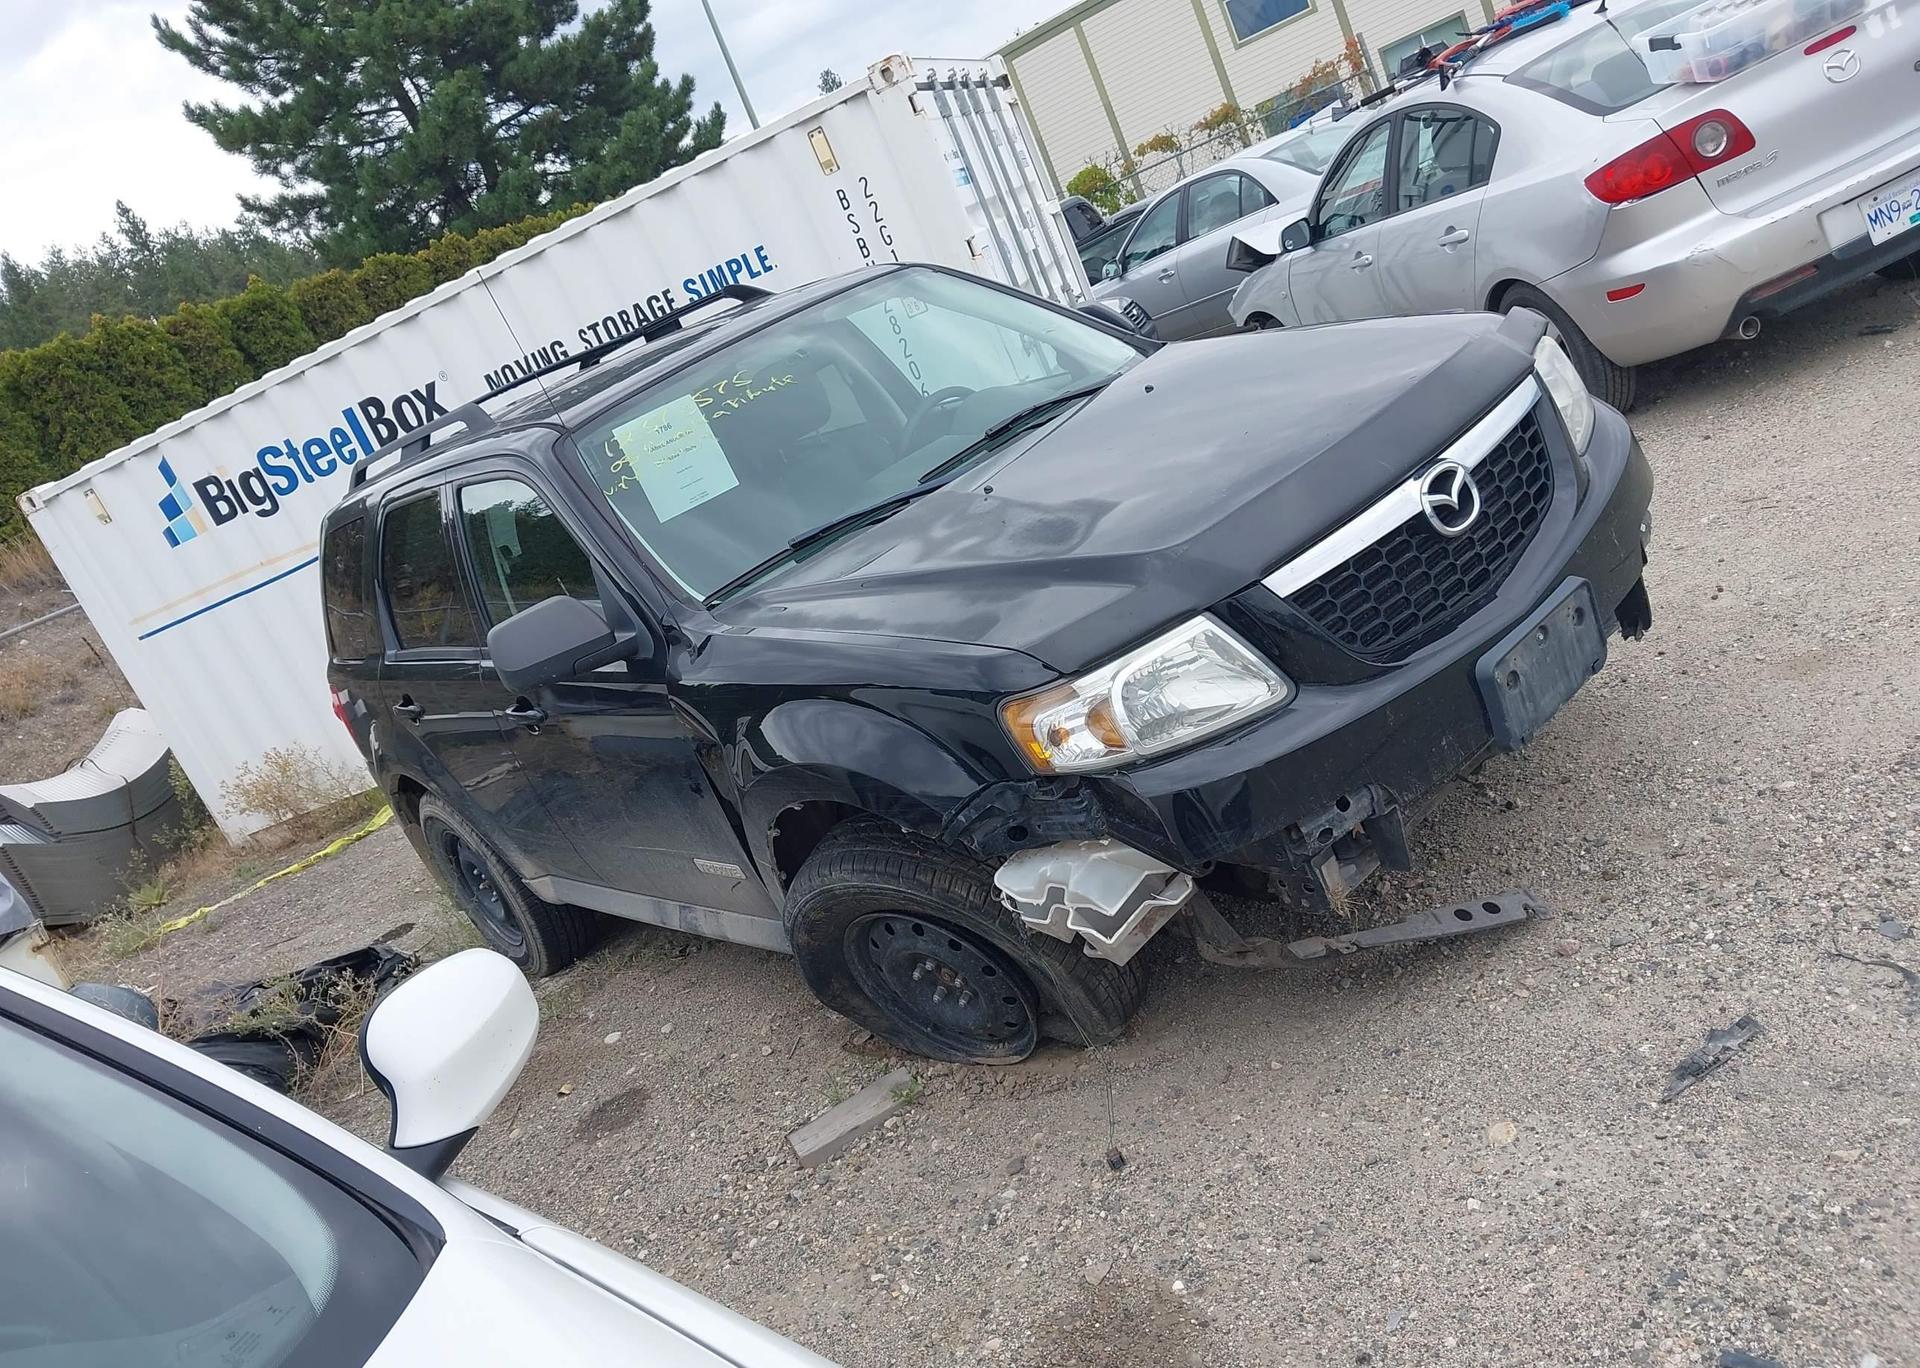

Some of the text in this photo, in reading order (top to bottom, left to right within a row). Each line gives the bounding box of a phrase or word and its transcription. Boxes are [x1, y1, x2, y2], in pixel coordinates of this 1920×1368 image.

[836, 189, 876, 267] BSB
[859, 176, 899, 262] 22G1
[1867, 200, 1901, 232] MN9
[484, 340, 570, 392] MOVING
[577, 288, 678, 350] STORAGE
[192, 380, 451, 527] BigSteelBox
[655, 422, 673, 434] 1786
